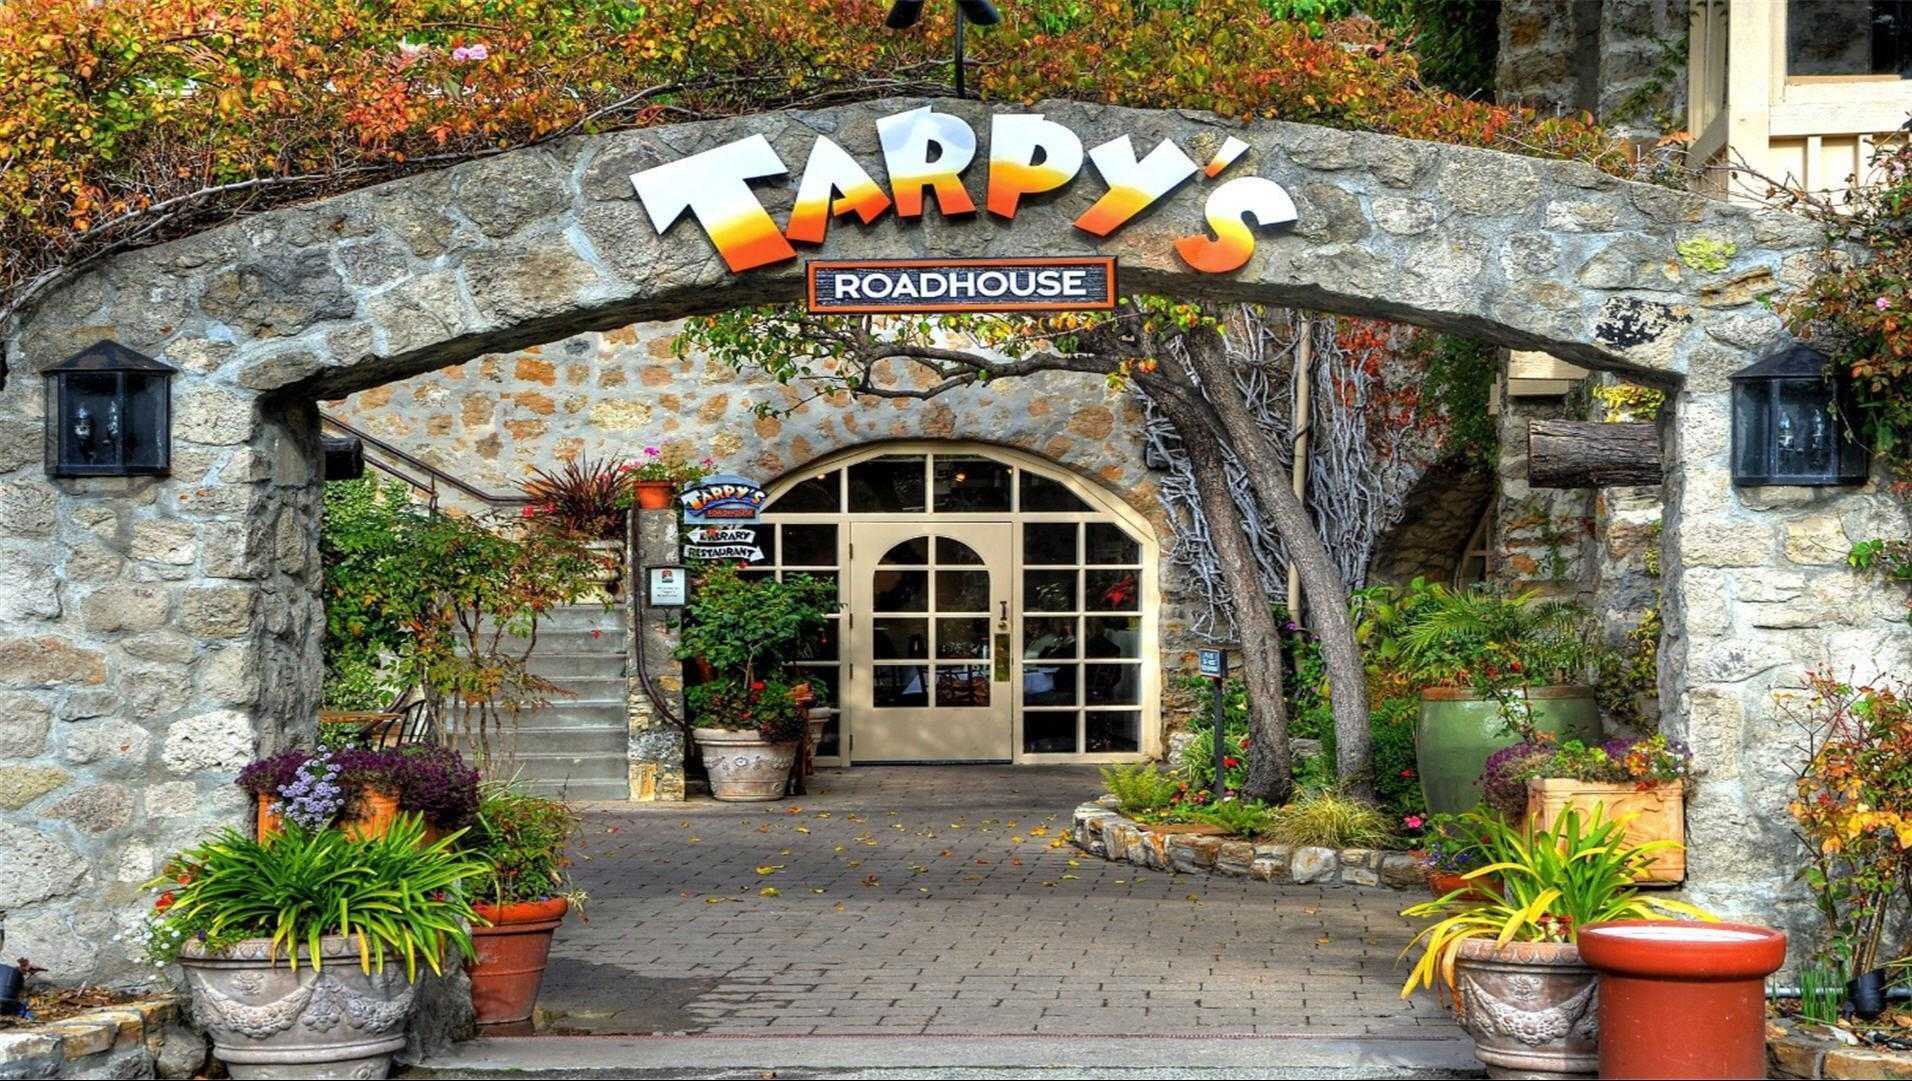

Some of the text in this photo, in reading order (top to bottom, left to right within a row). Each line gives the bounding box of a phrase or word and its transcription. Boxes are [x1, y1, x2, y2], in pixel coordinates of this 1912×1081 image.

[629, 105, 1298, 273] TARPY'S
[834, 270, 1087, 299] ROADHOUSE
[680, 484, 766, 510] TARPY'S
[699, 530, 751, 541] LRARY
[688, 547, 755, 558] RESTAURANT
